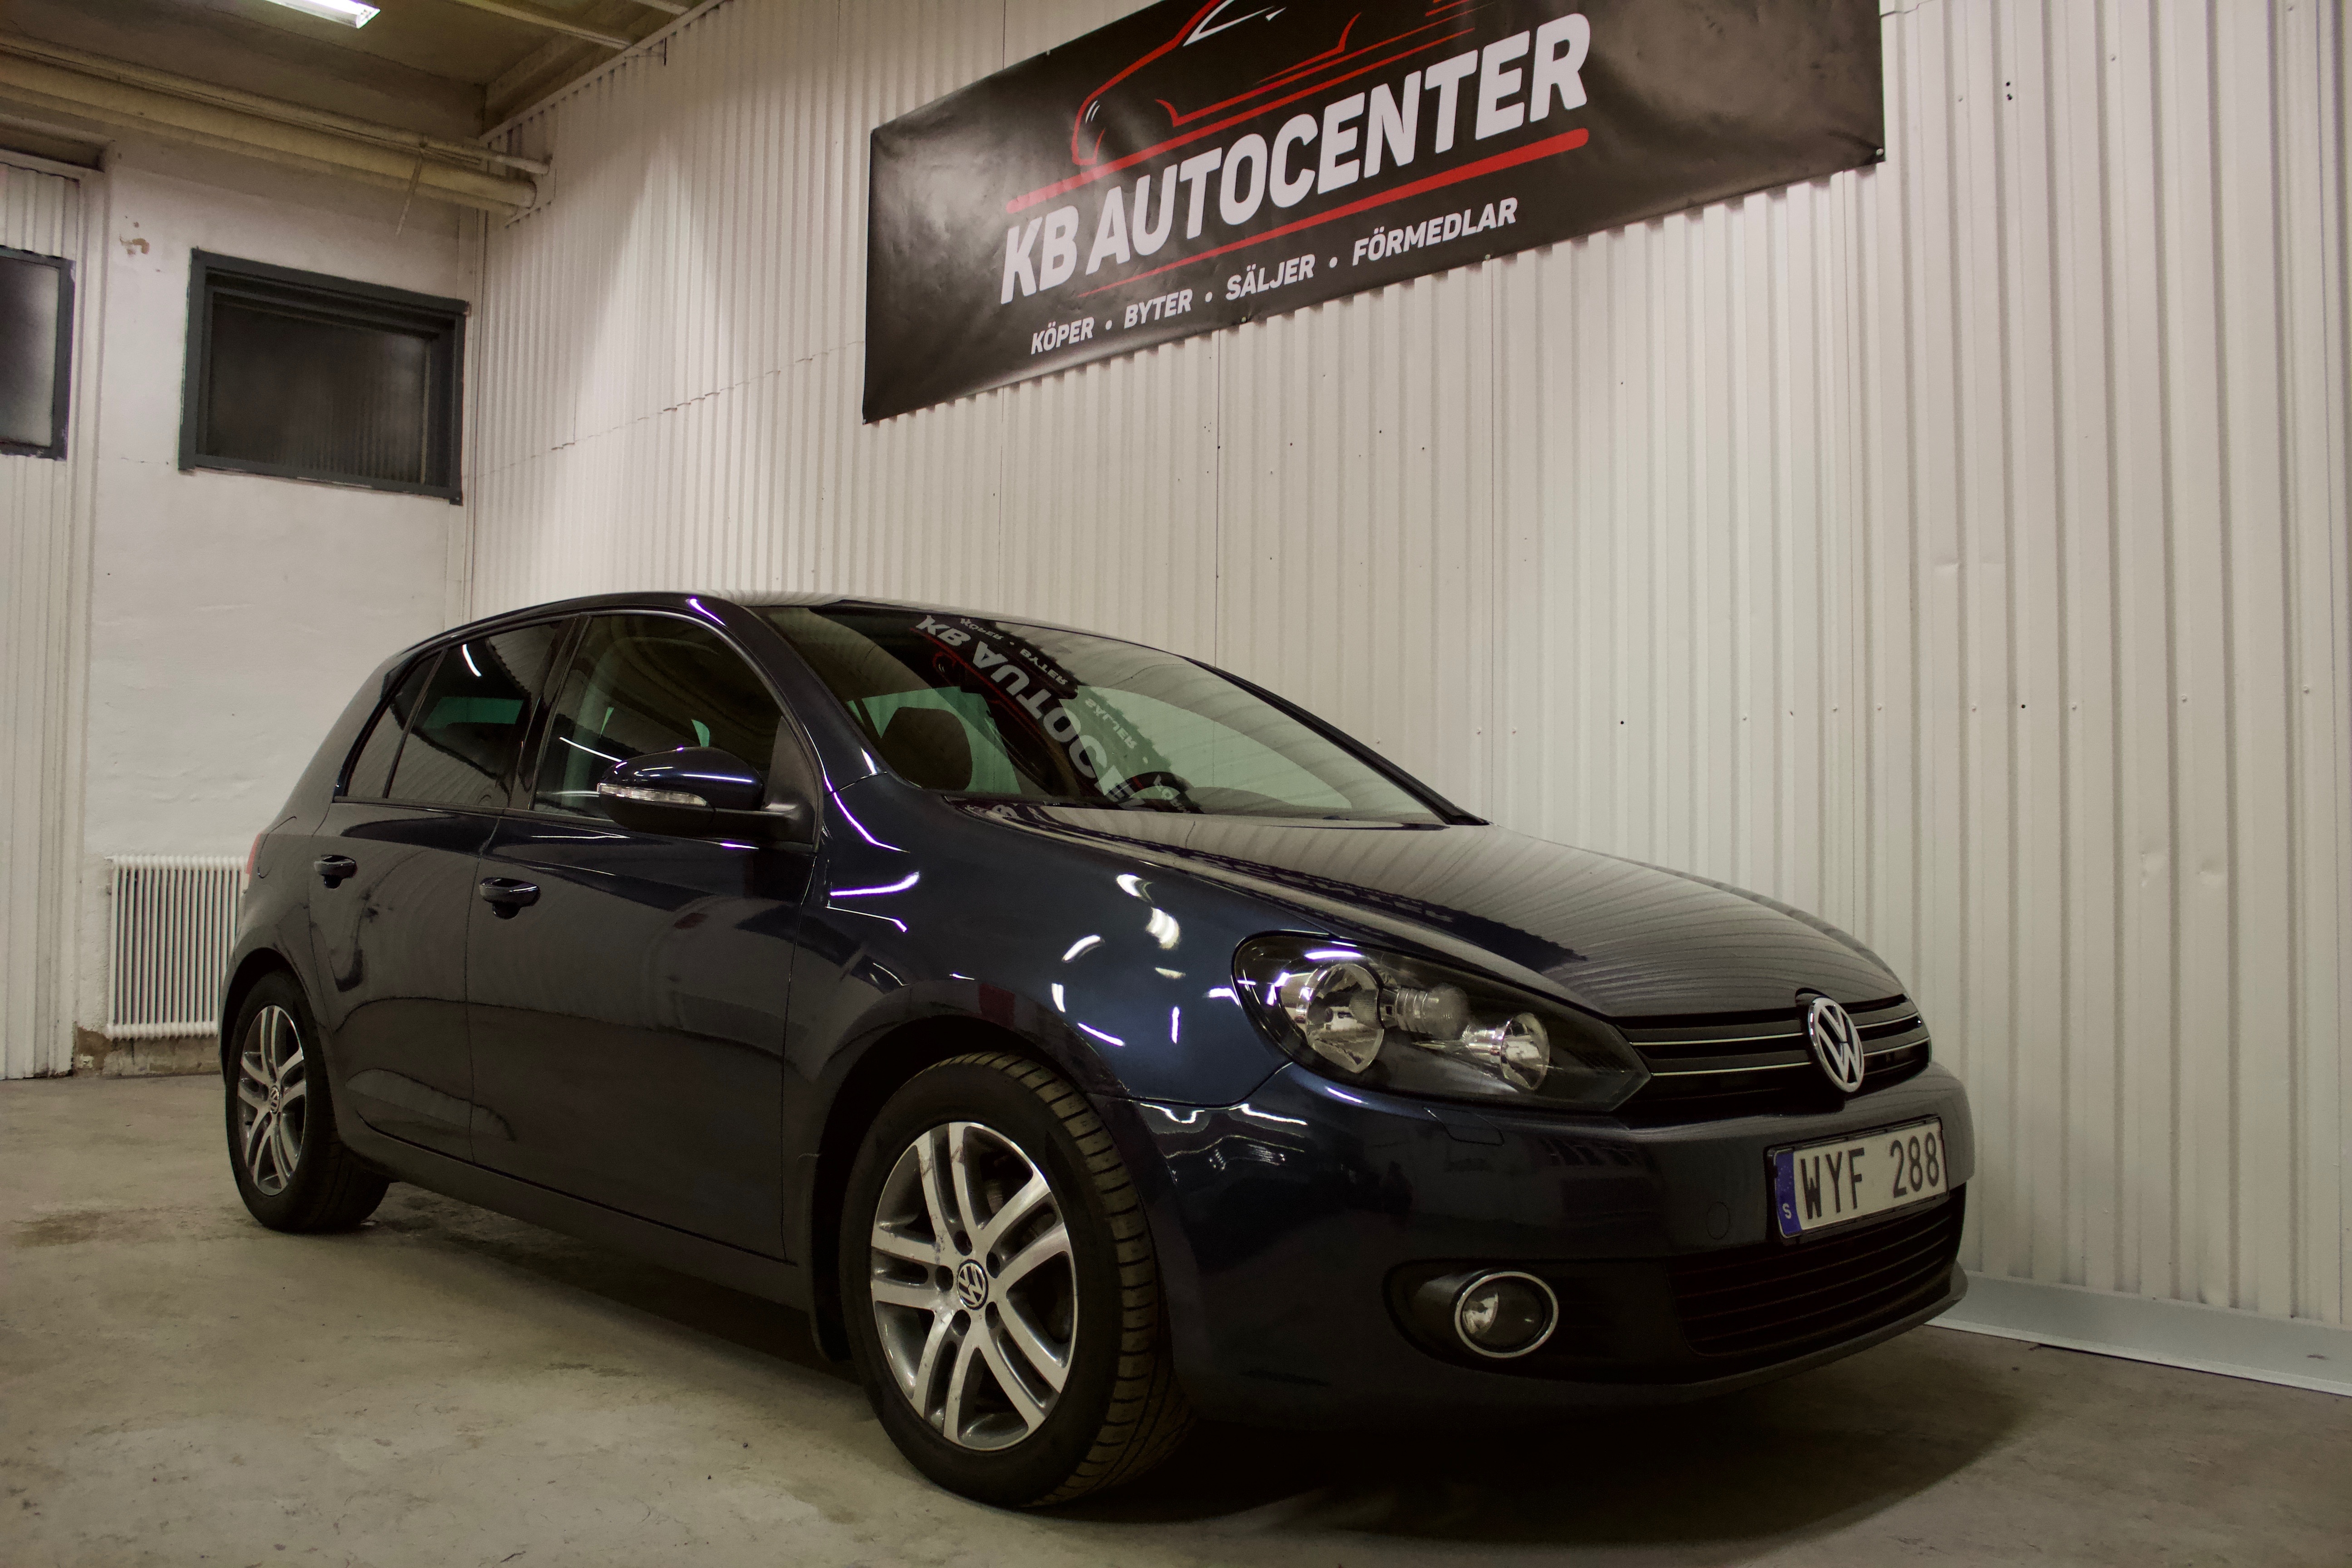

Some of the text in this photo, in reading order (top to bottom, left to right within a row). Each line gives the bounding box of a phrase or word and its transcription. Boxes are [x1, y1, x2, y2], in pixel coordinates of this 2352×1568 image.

[1001, 13, 1591, 304] KB AUTOCENTER
[1030, 197, 1518, 355] KÖPER BYTER SÄLJER FÖRMEDLAR
[1782, 1202, 1792, 1220] S
[1799, 1132, 1940, 1220] WYF 288
